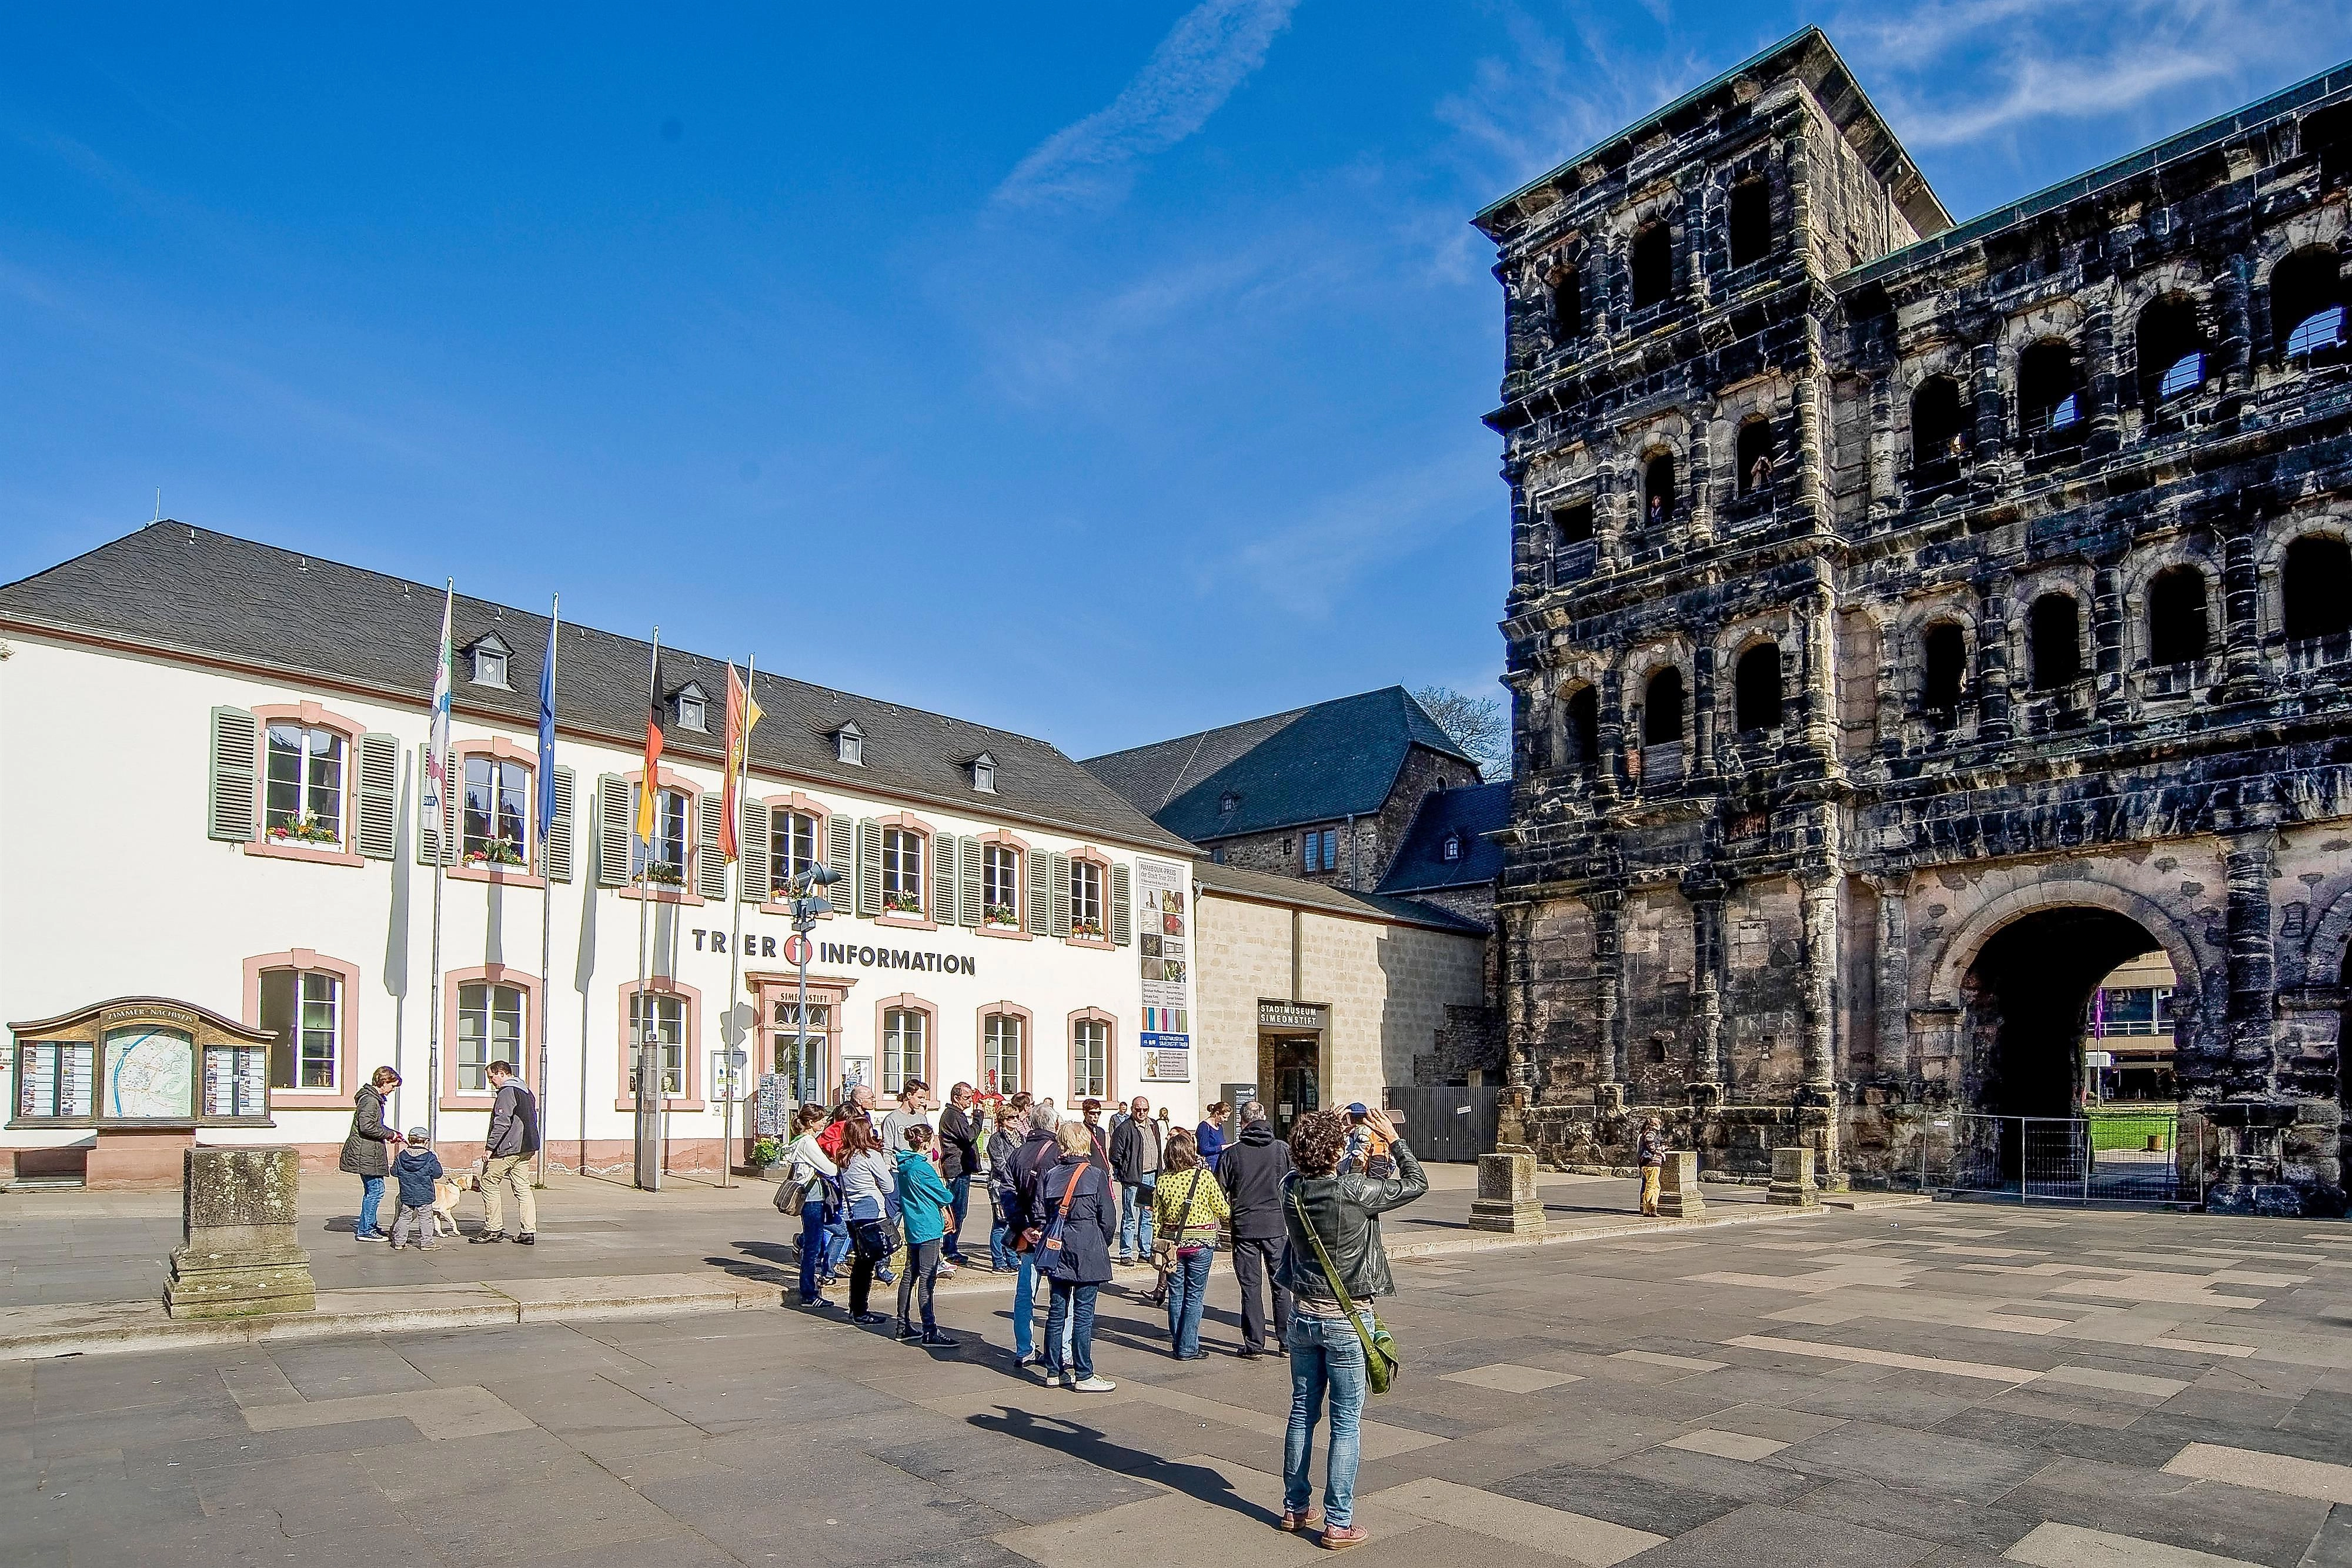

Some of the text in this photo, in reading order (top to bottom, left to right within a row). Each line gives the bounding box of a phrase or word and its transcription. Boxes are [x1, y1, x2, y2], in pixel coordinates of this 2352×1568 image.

[821, 942, 975, 975] INFORMATION
[780, 992, 827, 1003] SIMENSTIFT
[1261, 1005, 1317, 1016] STADTMUSEUM
[1261, 1014, 1317, 1025] SIMEONSTIFT
